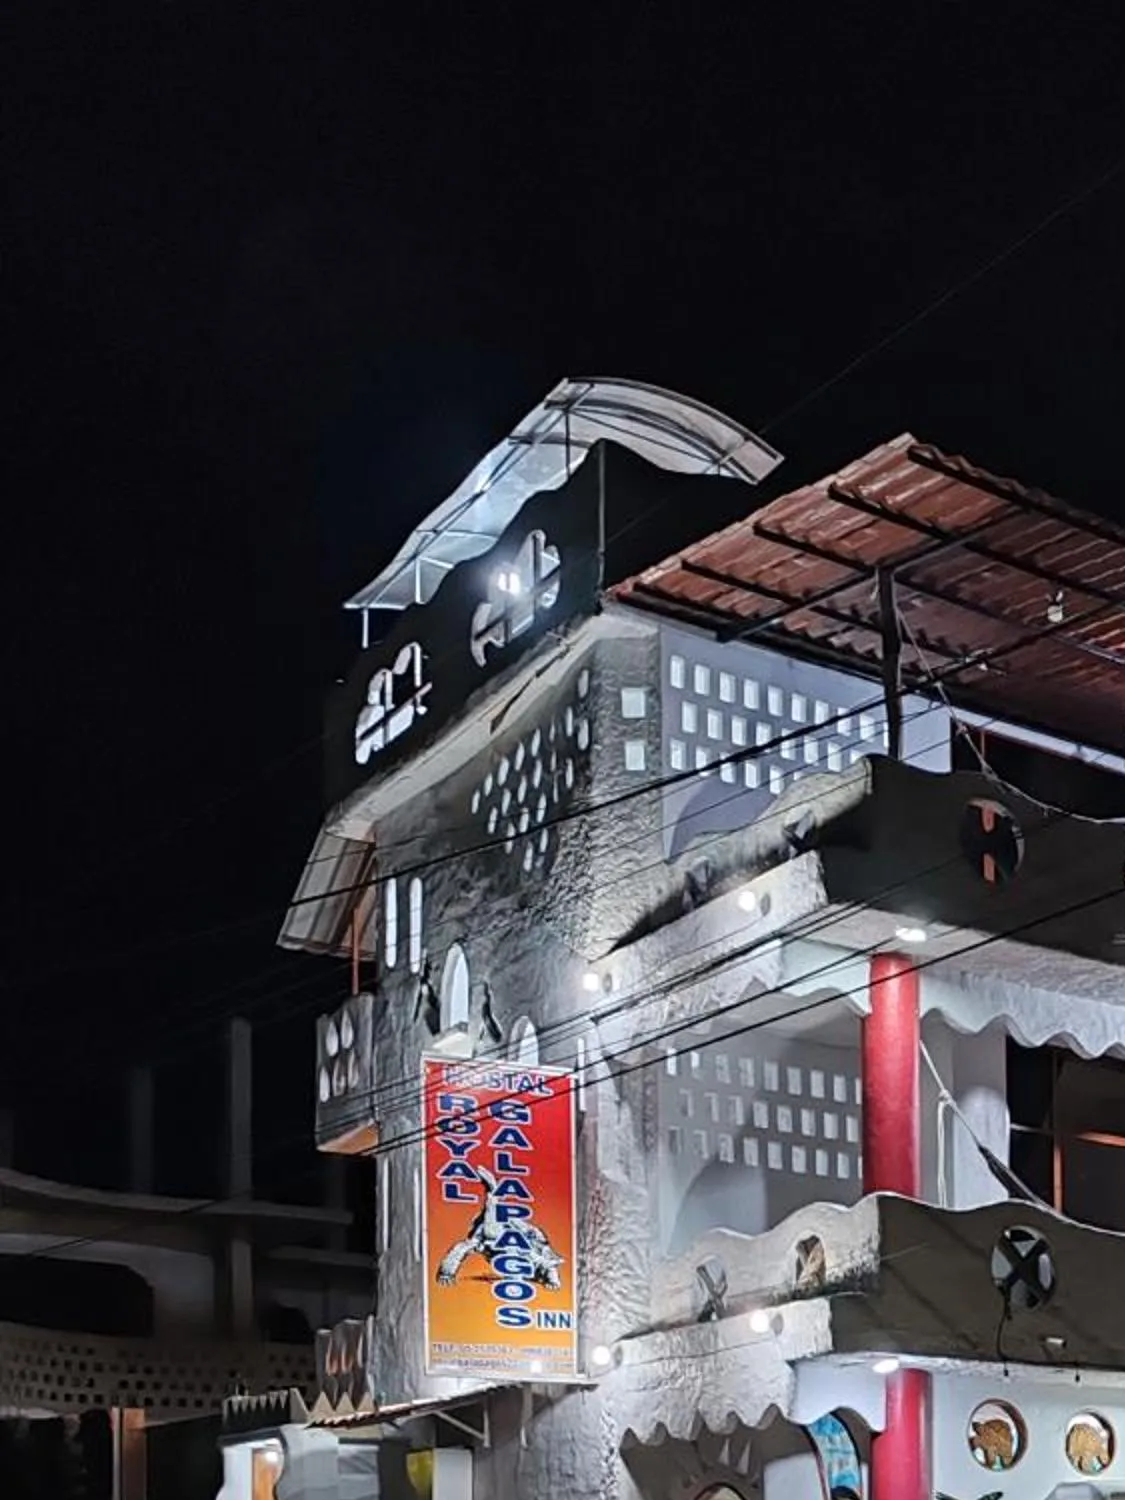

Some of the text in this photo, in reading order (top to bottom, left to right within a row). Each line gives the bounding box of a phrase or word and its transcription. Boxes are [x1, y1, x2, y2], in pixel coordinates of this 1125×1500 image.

[437, 1094, 481, 1202] ROYAL
[491, 1099, 536, 1328] GALAPAGOS
[536, 1311, 572, 1328] INN
